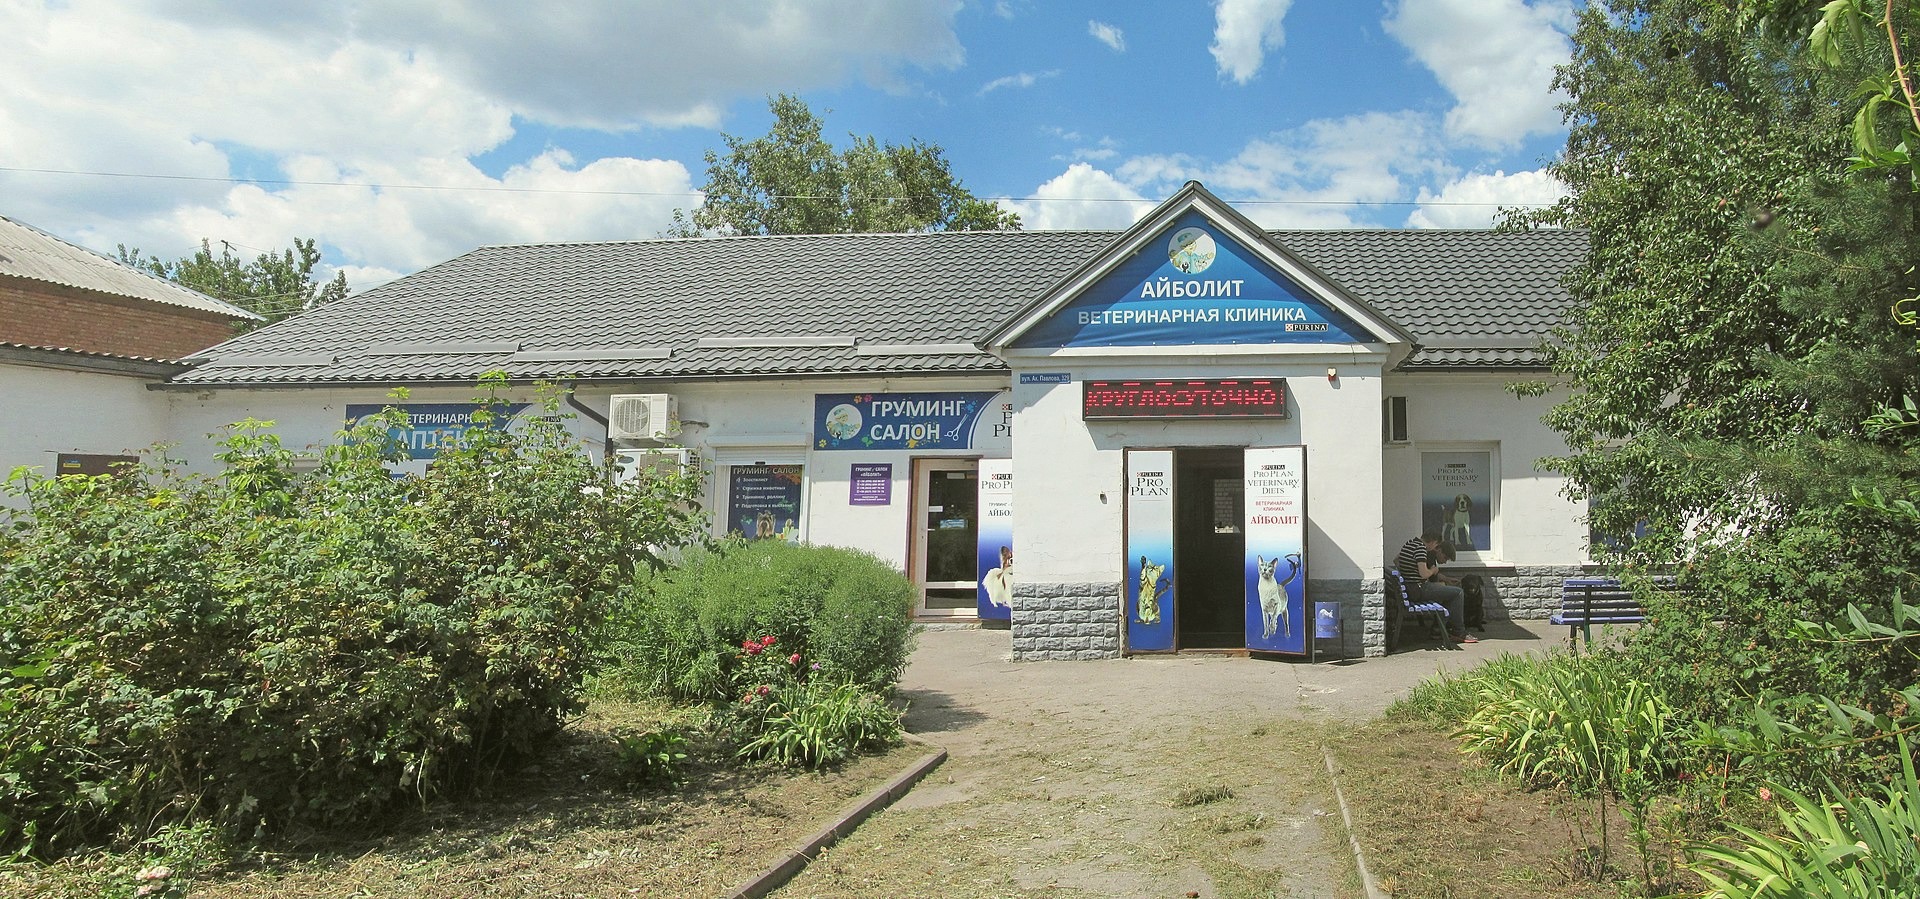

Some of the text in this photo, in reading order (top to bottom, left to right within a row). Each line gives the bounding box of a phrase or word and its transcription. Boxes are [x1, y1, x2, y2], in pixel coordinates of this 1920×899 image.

[1141, 277, 1244, 298] АЙБОЛИТ
[1078, 308, 1307, 325] ВЕТЕРИНАРНАЯ КЛИНИКА
[871, 400, 966, 417] ГРУМИНГ
[394, 430, 481, 449] АПТЕК
[870, 424, 941, 441] САЛОН
[981, 480, 1001, 489] PRO
[1137, 477, 1164, 487] PRO
[1131, 486, 1169, 496] PLAN
[1262, 487, 1285, 495] DIETS
[1250, 513, 1299, 525] АЙБОЛИТ
